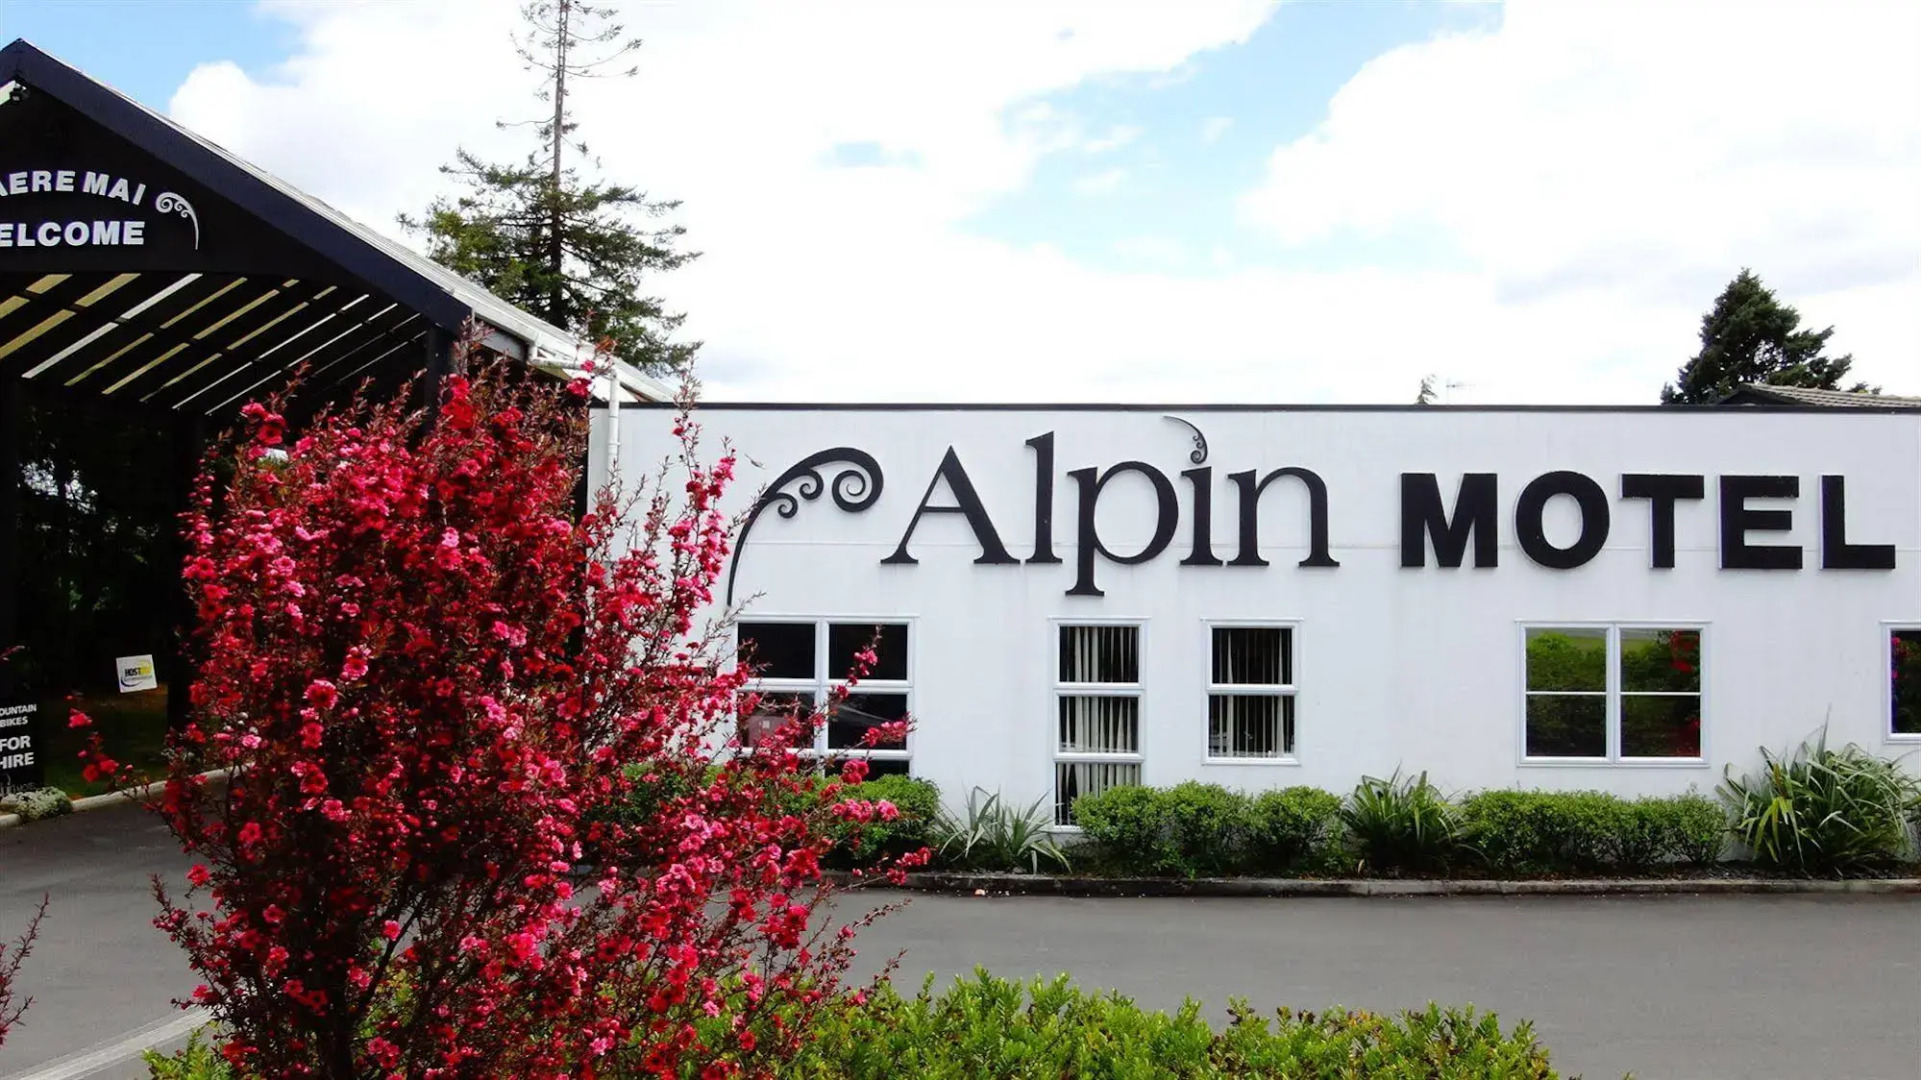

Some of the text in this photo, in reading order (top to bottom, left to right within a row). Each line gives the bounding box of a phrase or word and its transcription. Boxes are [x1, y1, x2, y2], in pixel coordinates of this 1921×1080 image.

[83, 171, 147, 206] MAI
[880, 416, 1896, 598] Alpin MOTEL
[0, 716, 28, 728] BIKES
[0, 735, 31, 752] FOR
